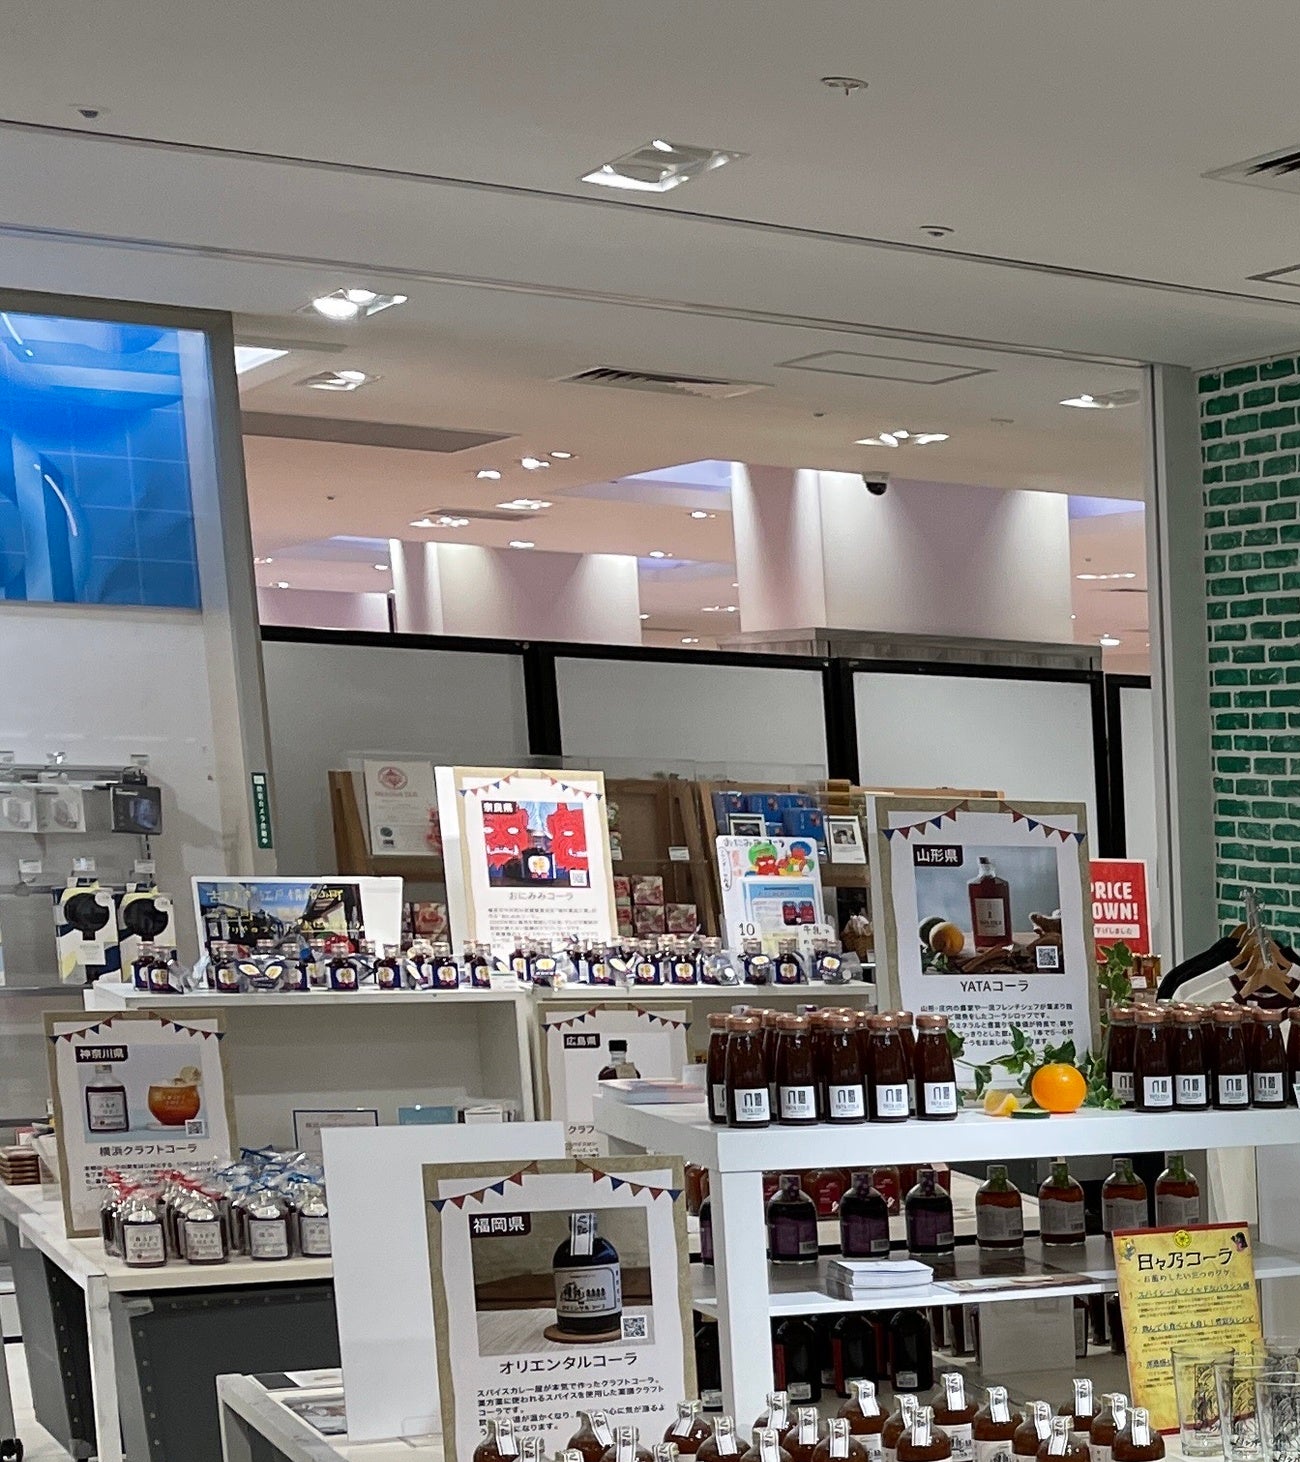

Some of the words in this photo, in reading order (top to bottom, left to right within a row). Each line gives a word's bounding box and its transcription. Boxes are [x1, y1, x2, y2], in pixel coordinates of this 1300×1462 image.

[916, 849, 958, 863] 山形県
[1092, 902, 1139, 920] OWN!
[960, 981, 1029, 993] YATAコーラ
[566, 1036, 597, 1047] 広島県
[80, 1047, 124, 1060] 神奈川県
[100, 1144, 197, 1157] 横浜クラフトコーラ
[473, 1216, 525, 1234] 福岡県
[1137, 1248, 1233, 1272] 日々乃コーラ
[499, 1352, 638, 1375] オリエンタルコーラ
